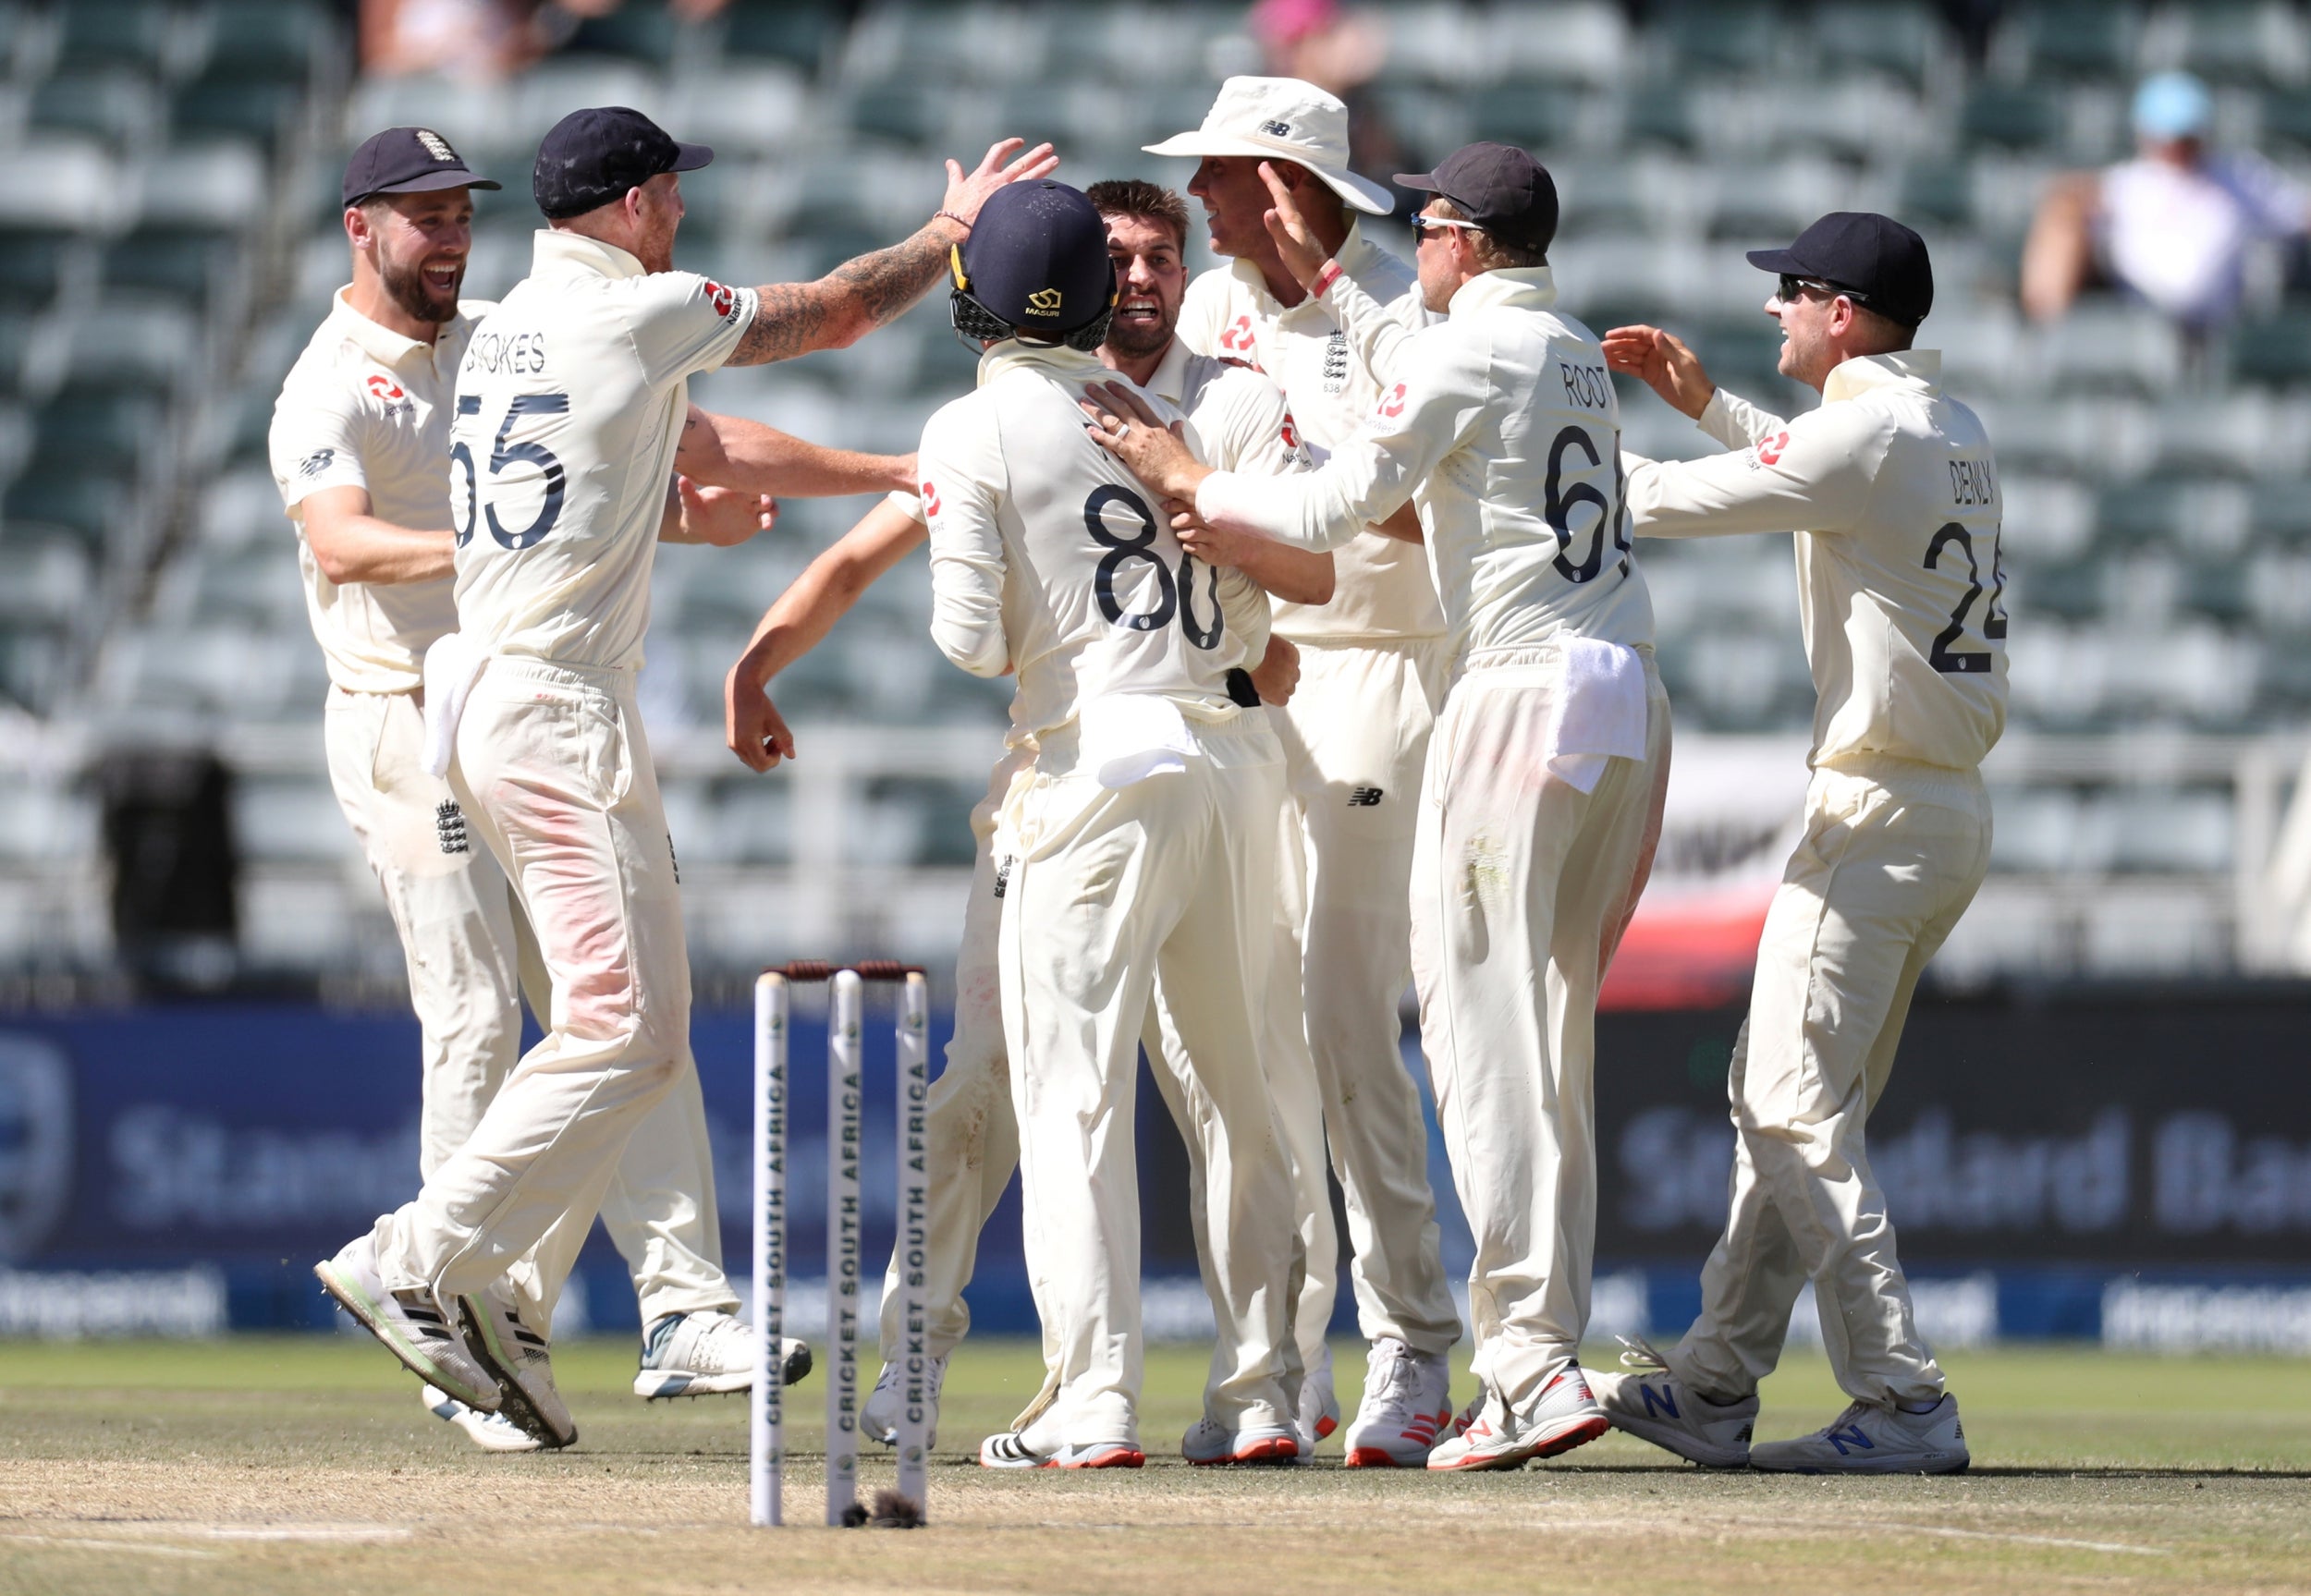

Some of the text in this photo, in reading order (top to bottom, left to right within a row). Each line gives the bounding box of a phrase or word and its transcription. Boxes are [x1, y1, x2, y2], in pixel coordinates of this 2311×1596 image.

[466, 332, 544, 375] STOKES
[1025, 307, 1060, 318] MASURI
[1323, 383, 1340, 394] 638
[1559, 362, 1613, 408] ROOT
[1949, 460, 1994, 506] DENLY
[1083, 482, 1225, 652] 80
[2152, 1109, 2311, 1233] Ba
[765, 1065, 784, 1426] CRICKET SOUTH AFRICA
[838, 1073, 860, 1432] CRICKET SOUTH AFRICA
[906, 1063, 925, 1424] CRICKET SOUTH AFRICA
